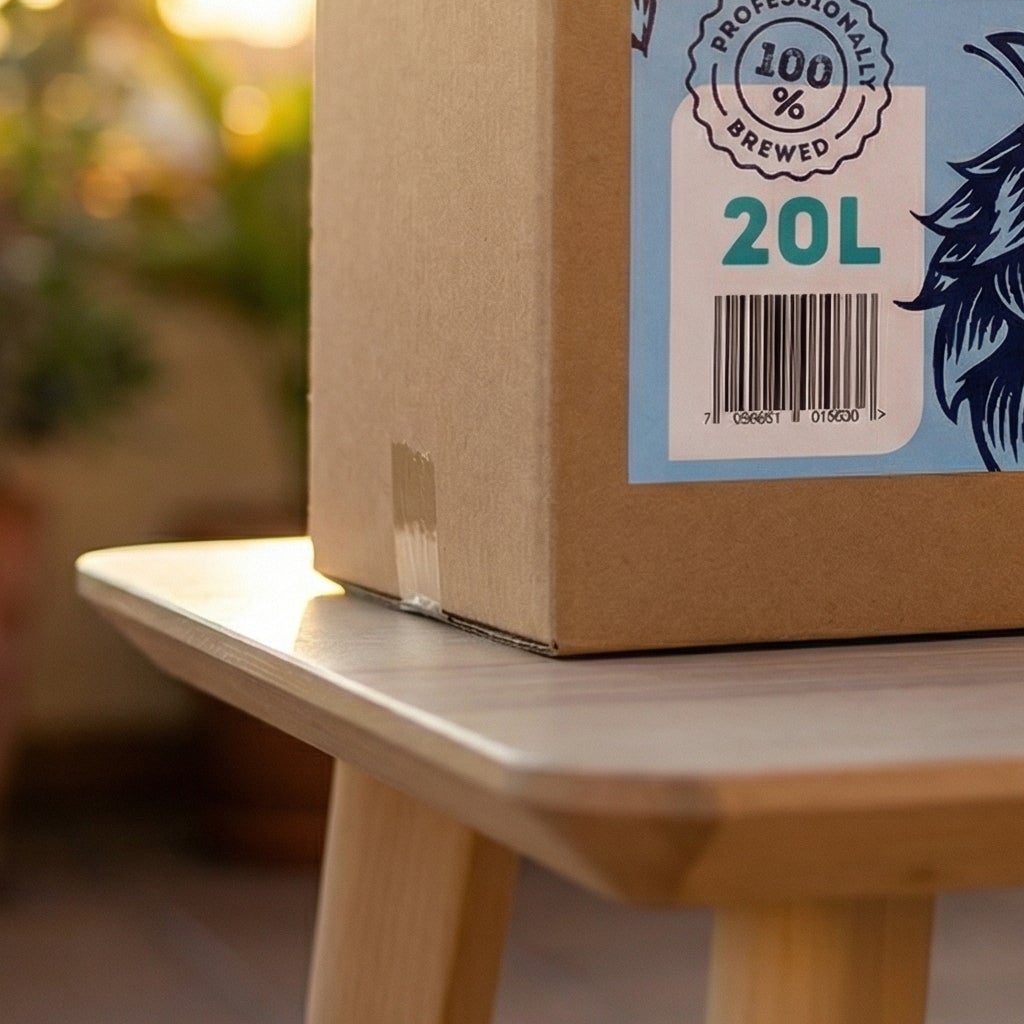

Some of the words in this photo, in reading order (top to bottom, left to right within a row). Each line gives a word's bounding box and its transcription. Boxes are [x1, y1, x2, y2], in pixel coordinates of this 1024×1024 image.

[755, 42, 833, 89] 100
[772, 86, 805, 120] %
[726, 118, 829, 163] BREWED
[721, 196, 882, 266] 20L
